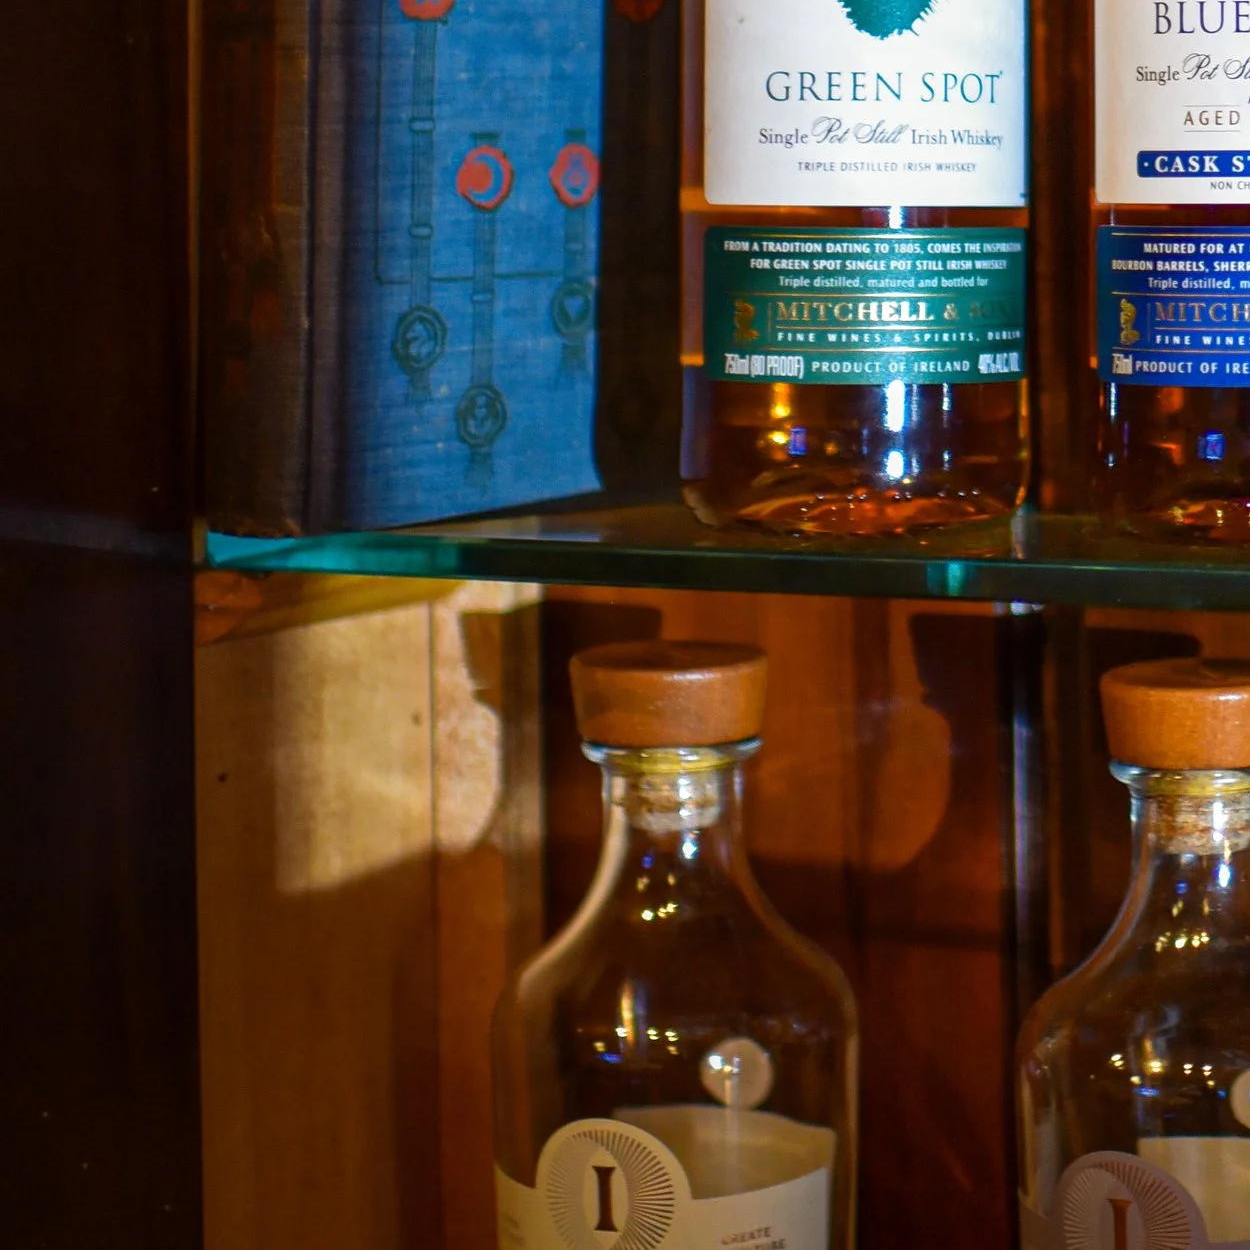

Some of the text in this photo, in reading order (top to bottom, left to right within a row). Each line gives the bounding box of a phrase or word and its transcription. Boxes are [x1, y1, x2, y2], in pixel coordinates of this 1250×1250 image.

[1136, 65, 1180, 86] Single
[1182, 52, 1218, 81] Pot
[766, 71, 1000, 104] GREEN SPOT
[1184, 110, 1241, 126] AGED
[758, 116, 1003, 150] Single Pot Still Irish Whiskey
[798, 162, 977, 172] TRIPLE DISTILLED IRISH WHISKEY
[1154, 154, 1220, 174] CASK
[1210, 181, 1232, 191] NON
[724, 241, 750, 252] FROM
[752, 242, 760, 252] A
[762, 242, 823, 253] TRADITION
[826, 243, 871, 253] DATING
[874, 243, 890, 254] TO
[927, 243, 962, 254] COMES
[964, 243, 982, 254] THE
[1143, 243, 1196, 254] MATURED
[1200, 243, 1224, 254] FOR
[1229, 243, 1245, 254] AT
[750, 259, 1007, 270] FOR GREEN SPOT SINGLE POT STILL IRISH WHISKEY
[1112, 260, 1154, 271] BOURBON
[1157, 261, 1210, 273] BARRELS,
[779, 276, 989, 289] Triple distilled, matured and bottled for
[1147, 277, 1178, 290] Triple
[1181, 278, 1236, 289] distilled,
[776, 301, 960, 321] MITCHELL &
[777, 332, 817, 342] FINE
[827, 333, 881, 343] WINES
[987, 330, 1022, 341] DUBLIN
[1155, 335, 1192, 345] FINE
[767, 355, 805, 379] PROOF)
[811, 361, 880, 373] PRODUCT
[888, 362, 907, 373] OF
[914, 361, 970, 372] IRELAND
[1136, 361, 1193, 373] PRODUCT
[1200, 362, 1219, 374] OF
[592, 1165, 619, 1232] I
